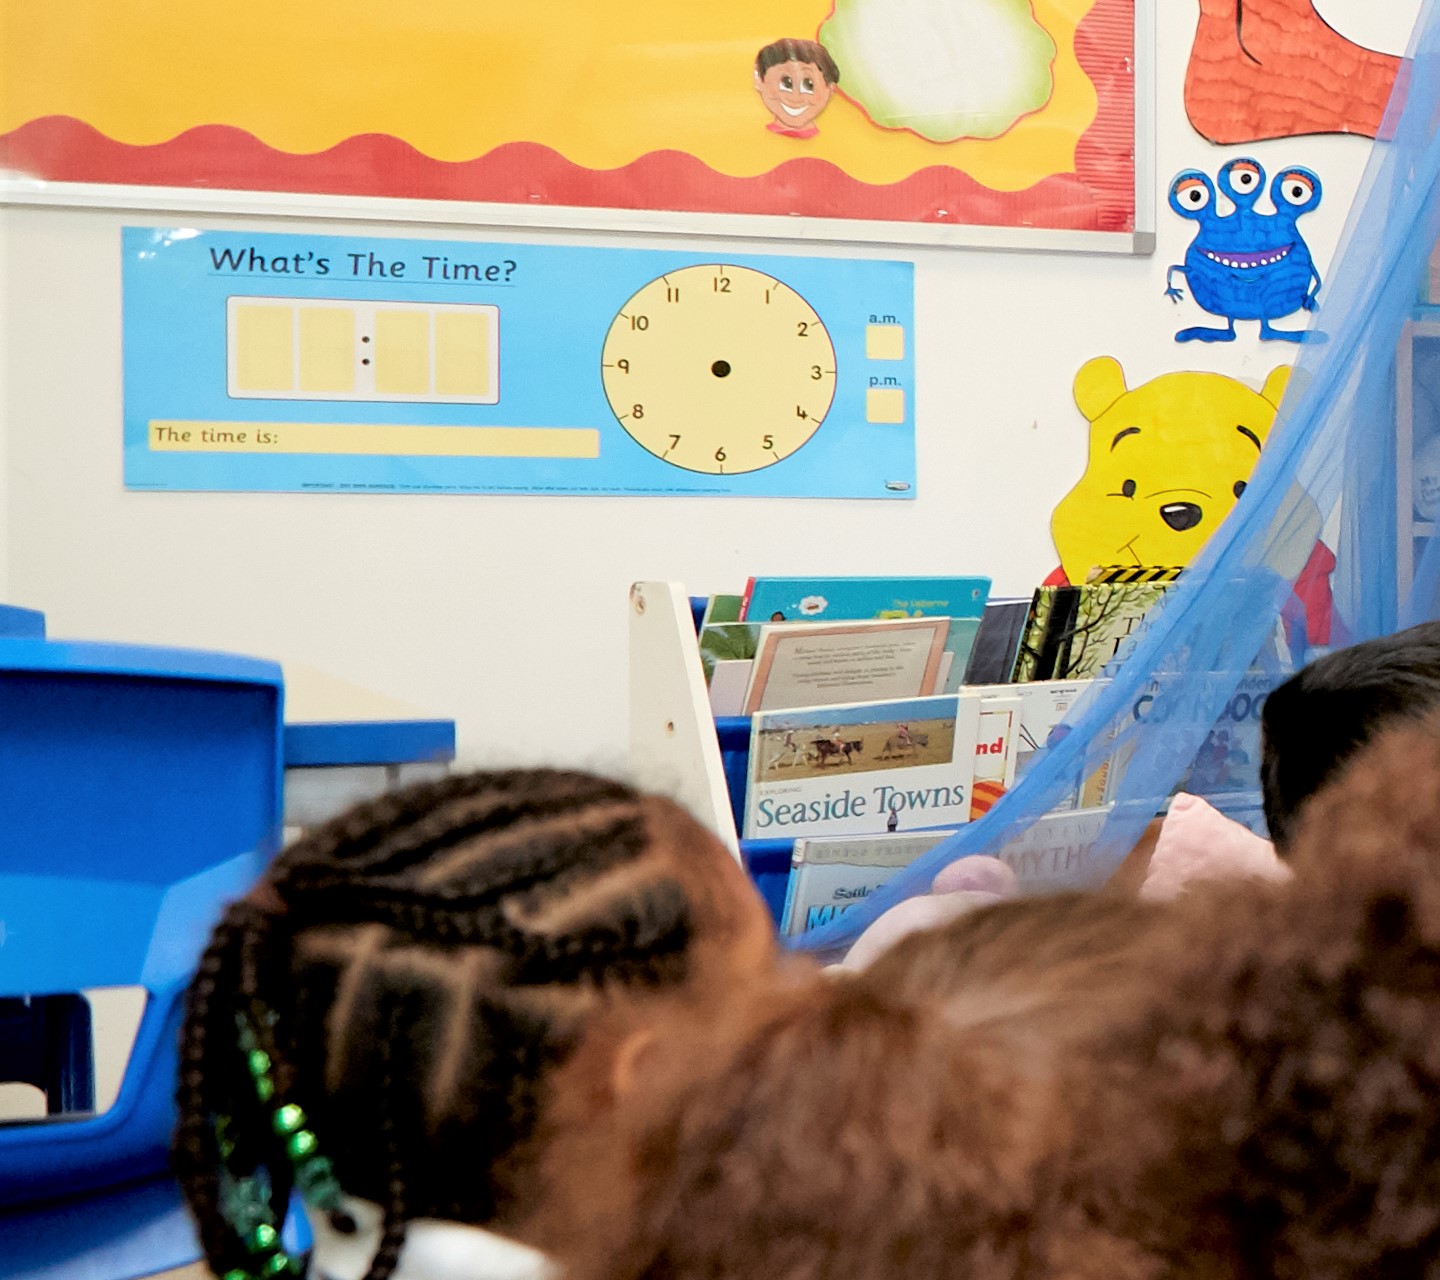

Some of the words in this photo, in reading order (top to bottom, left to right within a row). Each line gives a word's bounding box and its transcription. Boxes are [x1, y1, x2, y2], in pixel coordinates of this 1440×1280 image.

[210, 247, 330, 276] What's
[347, 252, 406, 278] The
[422, 256, 518, 282] Time?
[713, 277, 732, 293] 12
[667, 287, 680, 303] 11
[765, 289, 771, 305] 1
[631, 315, 649, 331] 10
[868, 312, 901, 325] a.m.
[797, 322, 809, 337] 2
[617, 359, 630, 375] 9
[810, 366, 822, 380] 3
[869, 375, 902, 388] p.m.
[632, 404, 644, 420] 8
[796, 405, 808, 420] 4
[155, 427, 191, 443] The
[201, 428, 247, 444] time
[256, 429, 279, 445] is:
[668, 434, 681, 450] 7
[762, 435, 773, 450] 5
[715, 447, 727, 462] 6
[757, 790, 868, 828] Seaside
[873, 783, 965, 815] Towns
